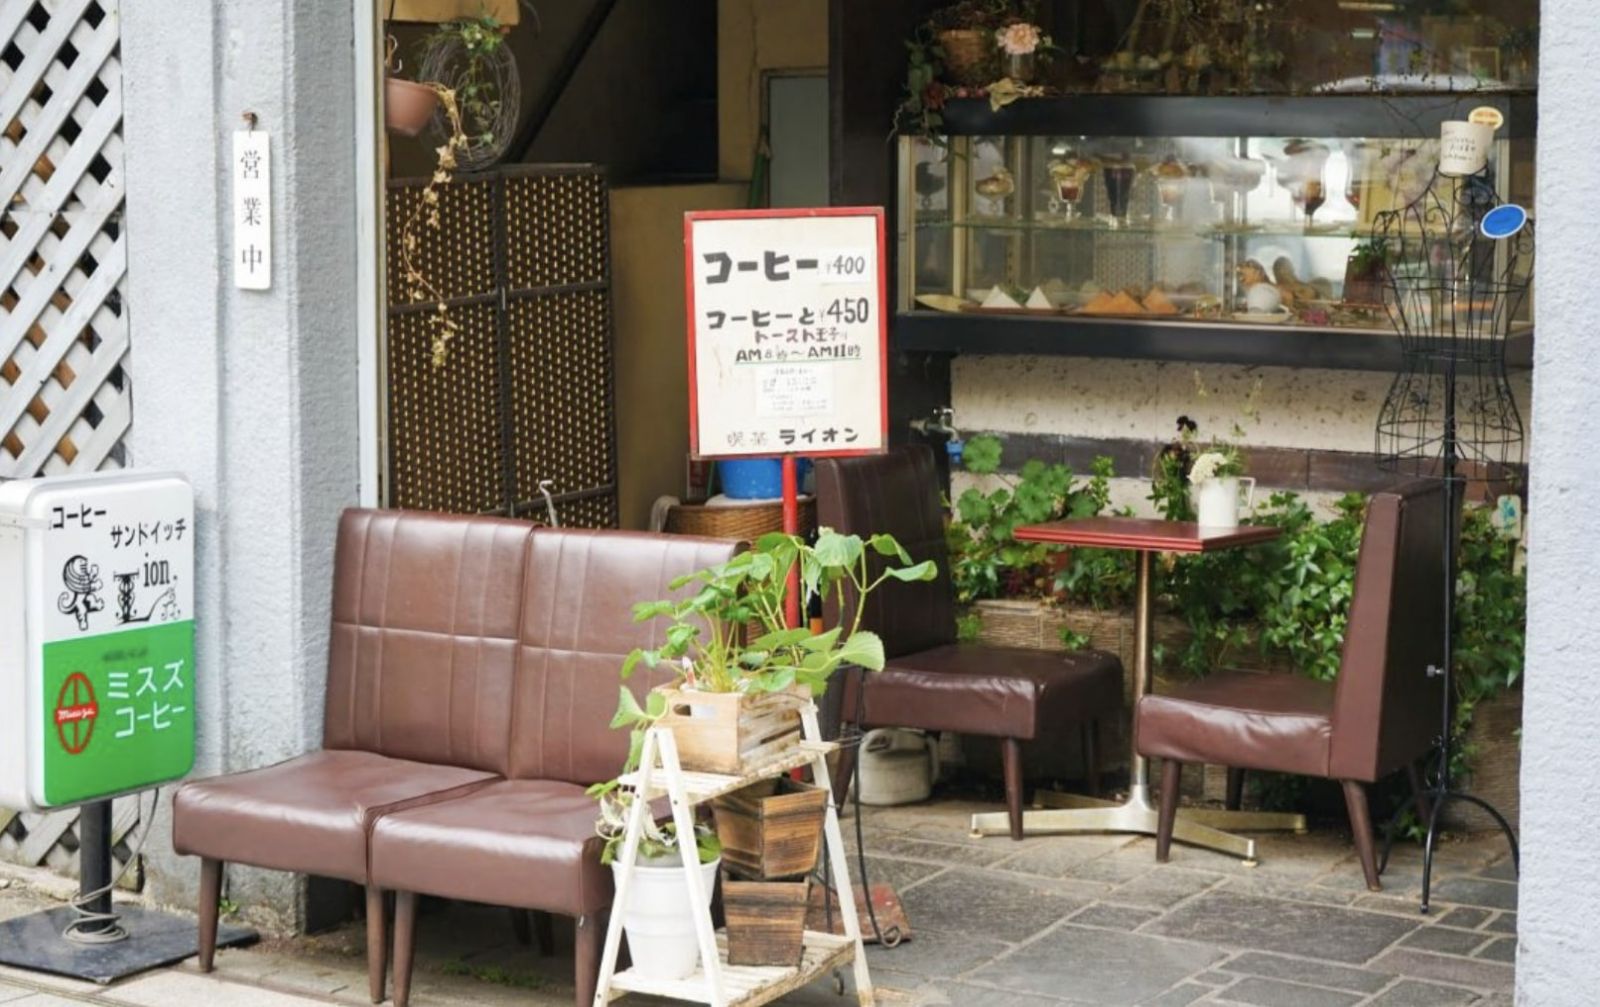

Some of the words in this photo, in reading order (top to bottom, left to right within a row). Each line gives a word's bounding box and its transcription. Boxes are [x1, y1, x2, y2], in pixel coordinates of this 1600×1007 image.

[241, 150, 262, 274] 営業中
[703, 251, 818, 284] コーヒー
[706, 308, 815, 329] コーヒーと
[779, 428, 858, 445] ライオン
[52, 504, 107, 529] コーヒー
[110, 517, 187, 549] サンドイッチ
[107, 659, 185, 699] ミスズ
[115, 701, 186, 738] コーヒー
